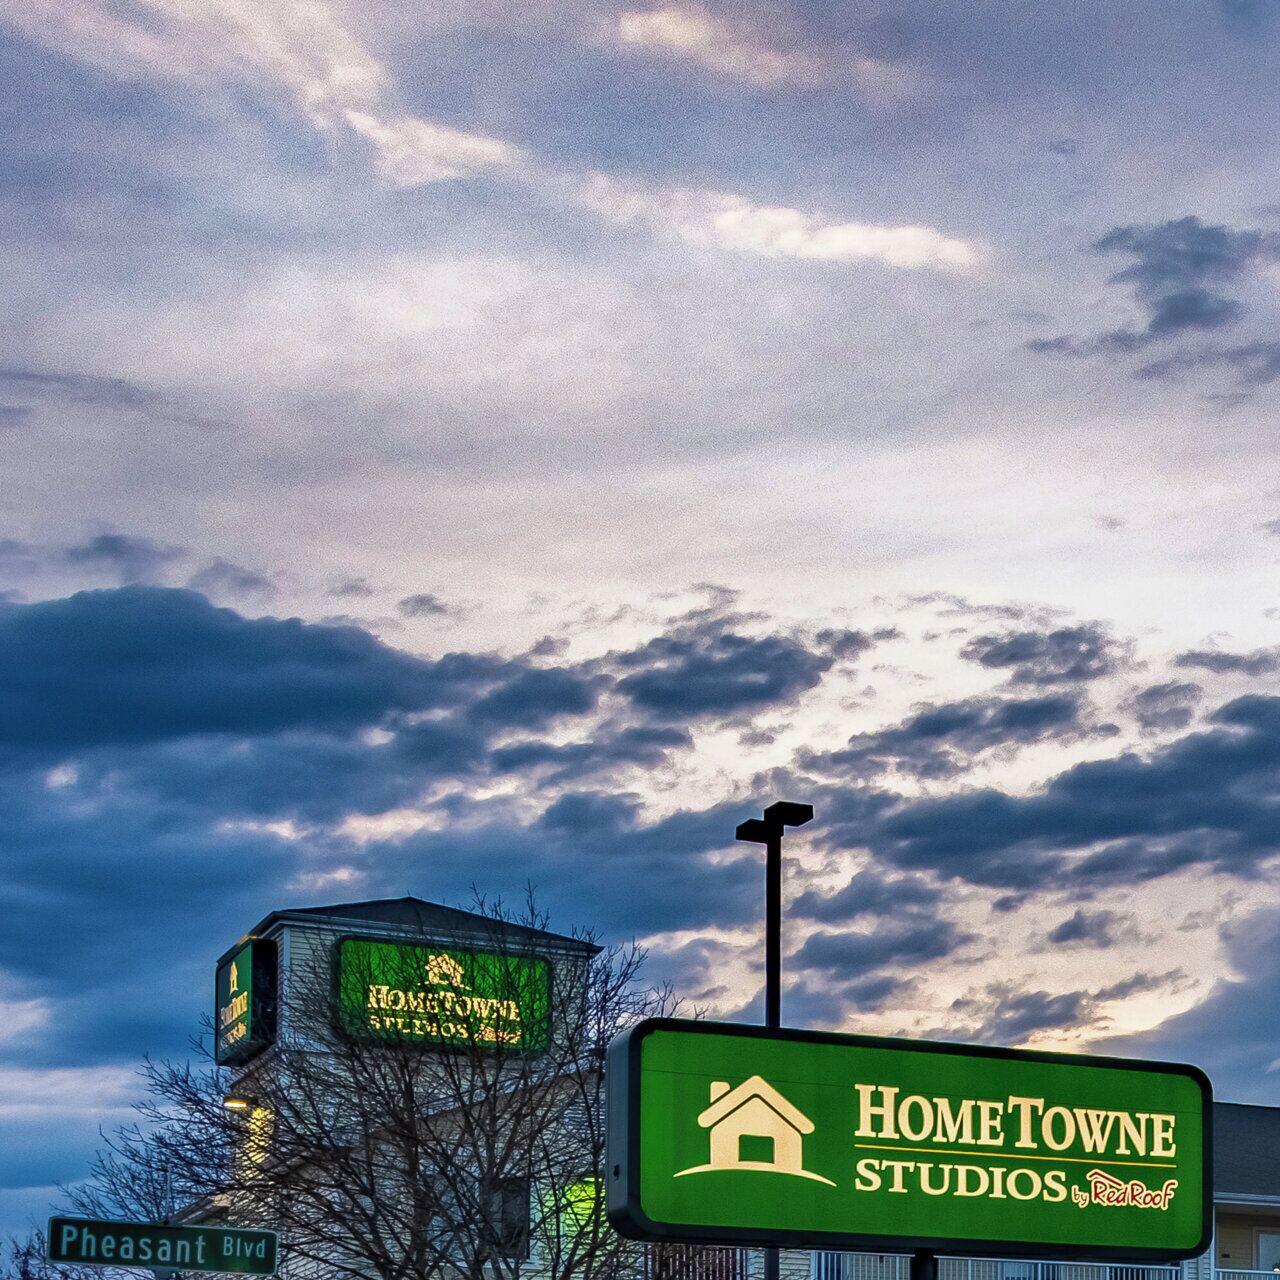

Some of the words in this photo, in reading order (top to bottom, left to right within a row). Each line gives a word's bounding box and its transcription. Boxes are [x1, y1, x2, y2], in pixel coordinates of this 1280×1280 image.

[854, 1158, 1068, 1202] STUDIOS
[1071, 1185, 1089, 1208] by
[61, 1224, 206, 1264] Pheasant
[223, 1236, 266, 1258] Blvd
